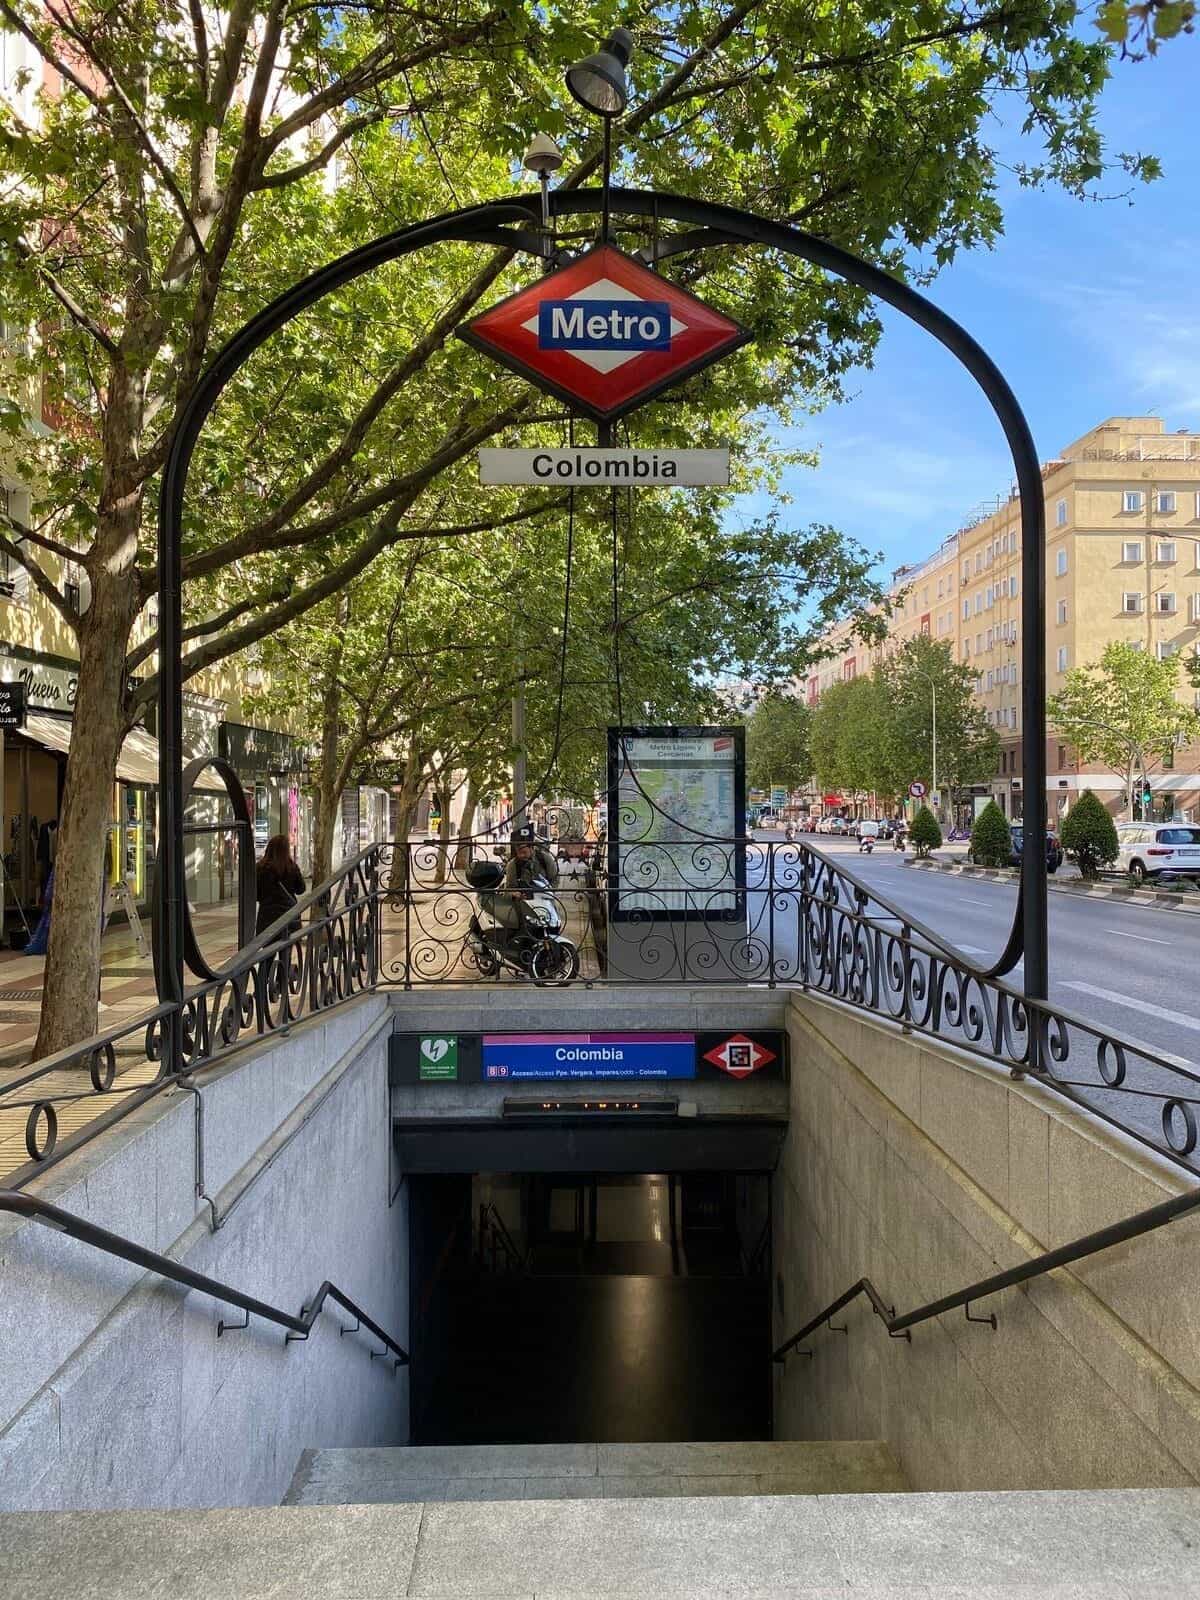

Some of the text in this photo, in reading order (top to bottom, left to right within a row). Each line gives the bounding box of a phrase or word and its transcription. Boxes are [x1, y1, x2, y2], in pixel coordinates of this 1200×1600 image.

[552, 307, 661, 340] Metro
[533, 454, 677, 478] Colombia
[19, 667, 60, 700] Nuevo
[555, 1047, 624, 1061] Colombia
